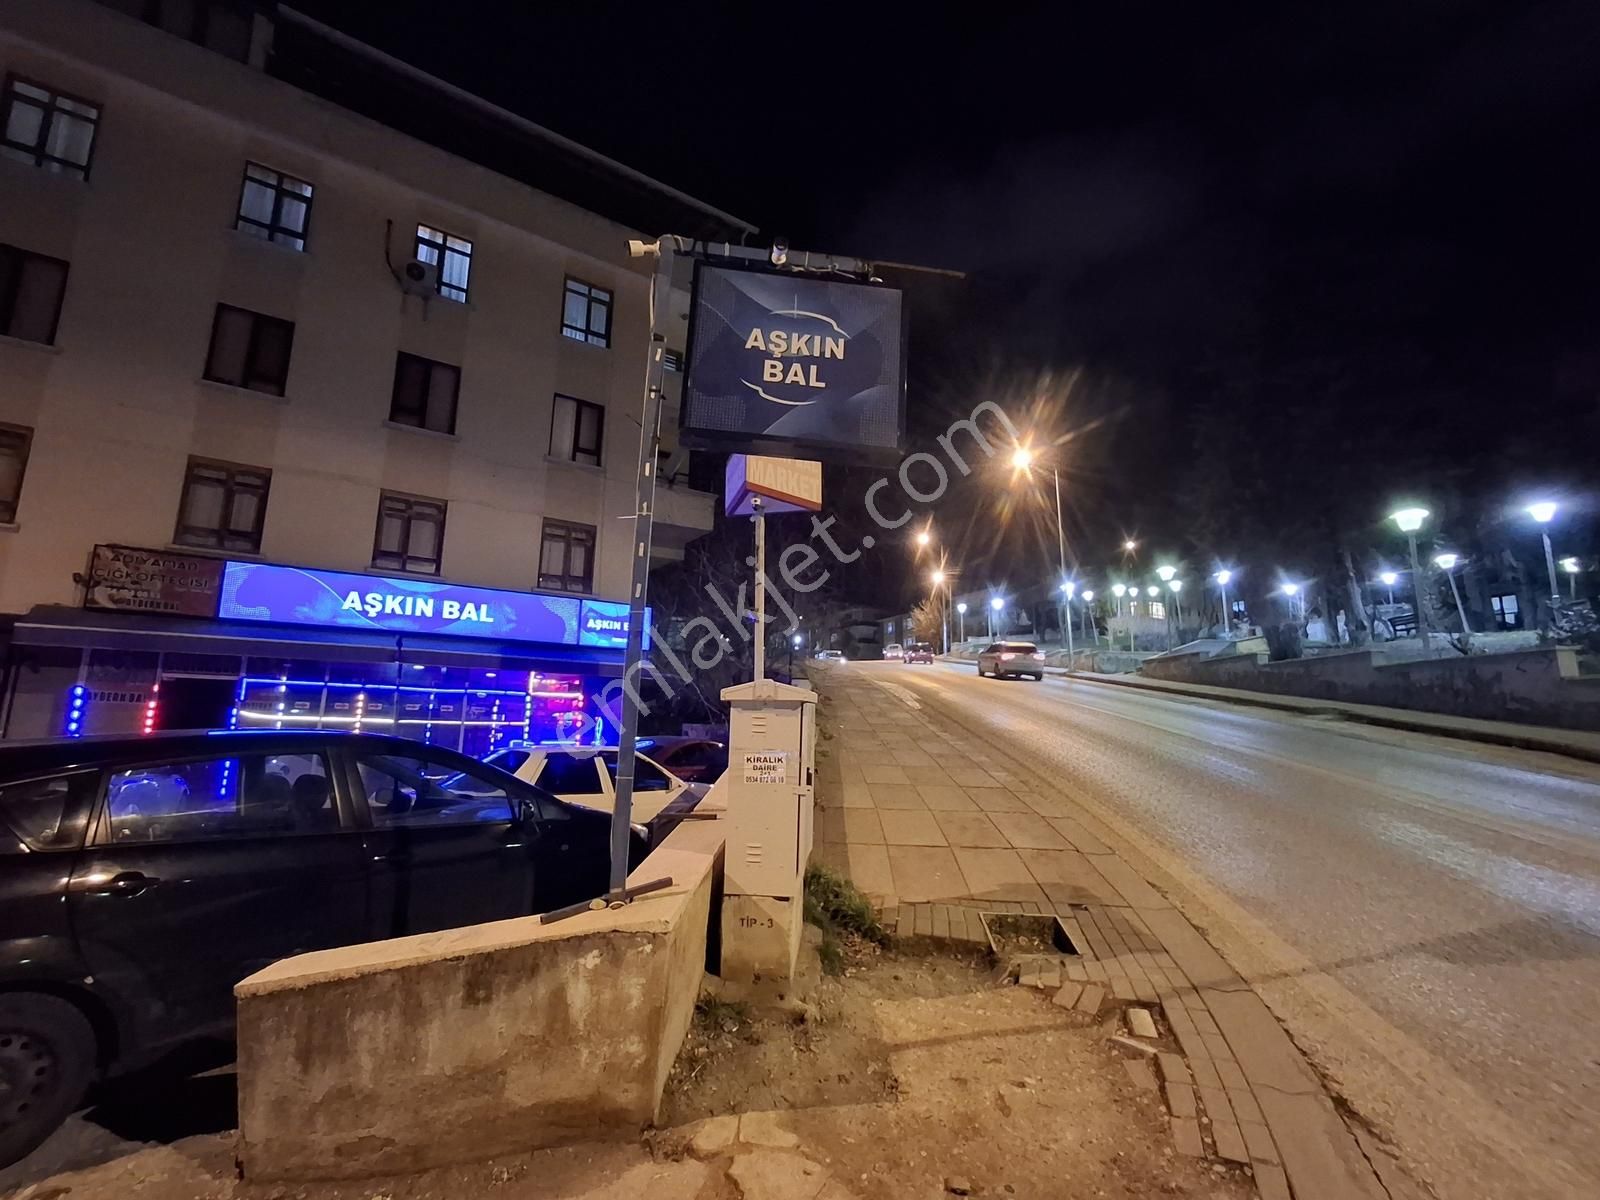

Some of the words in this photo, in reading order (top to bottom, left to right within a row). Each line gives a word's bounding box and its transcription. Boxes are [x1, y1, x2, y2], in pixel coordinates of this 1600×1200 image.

[745, 328, 845, 360] AŞKIN
[763, 360, 826, 388] BAL
[749, 461, 820, 501] MARKET
[341, 591, 433, 617] AŞKIN
[442, 600, 494, 622] BAL
[587, 618, 621, 631] AŞKIN
